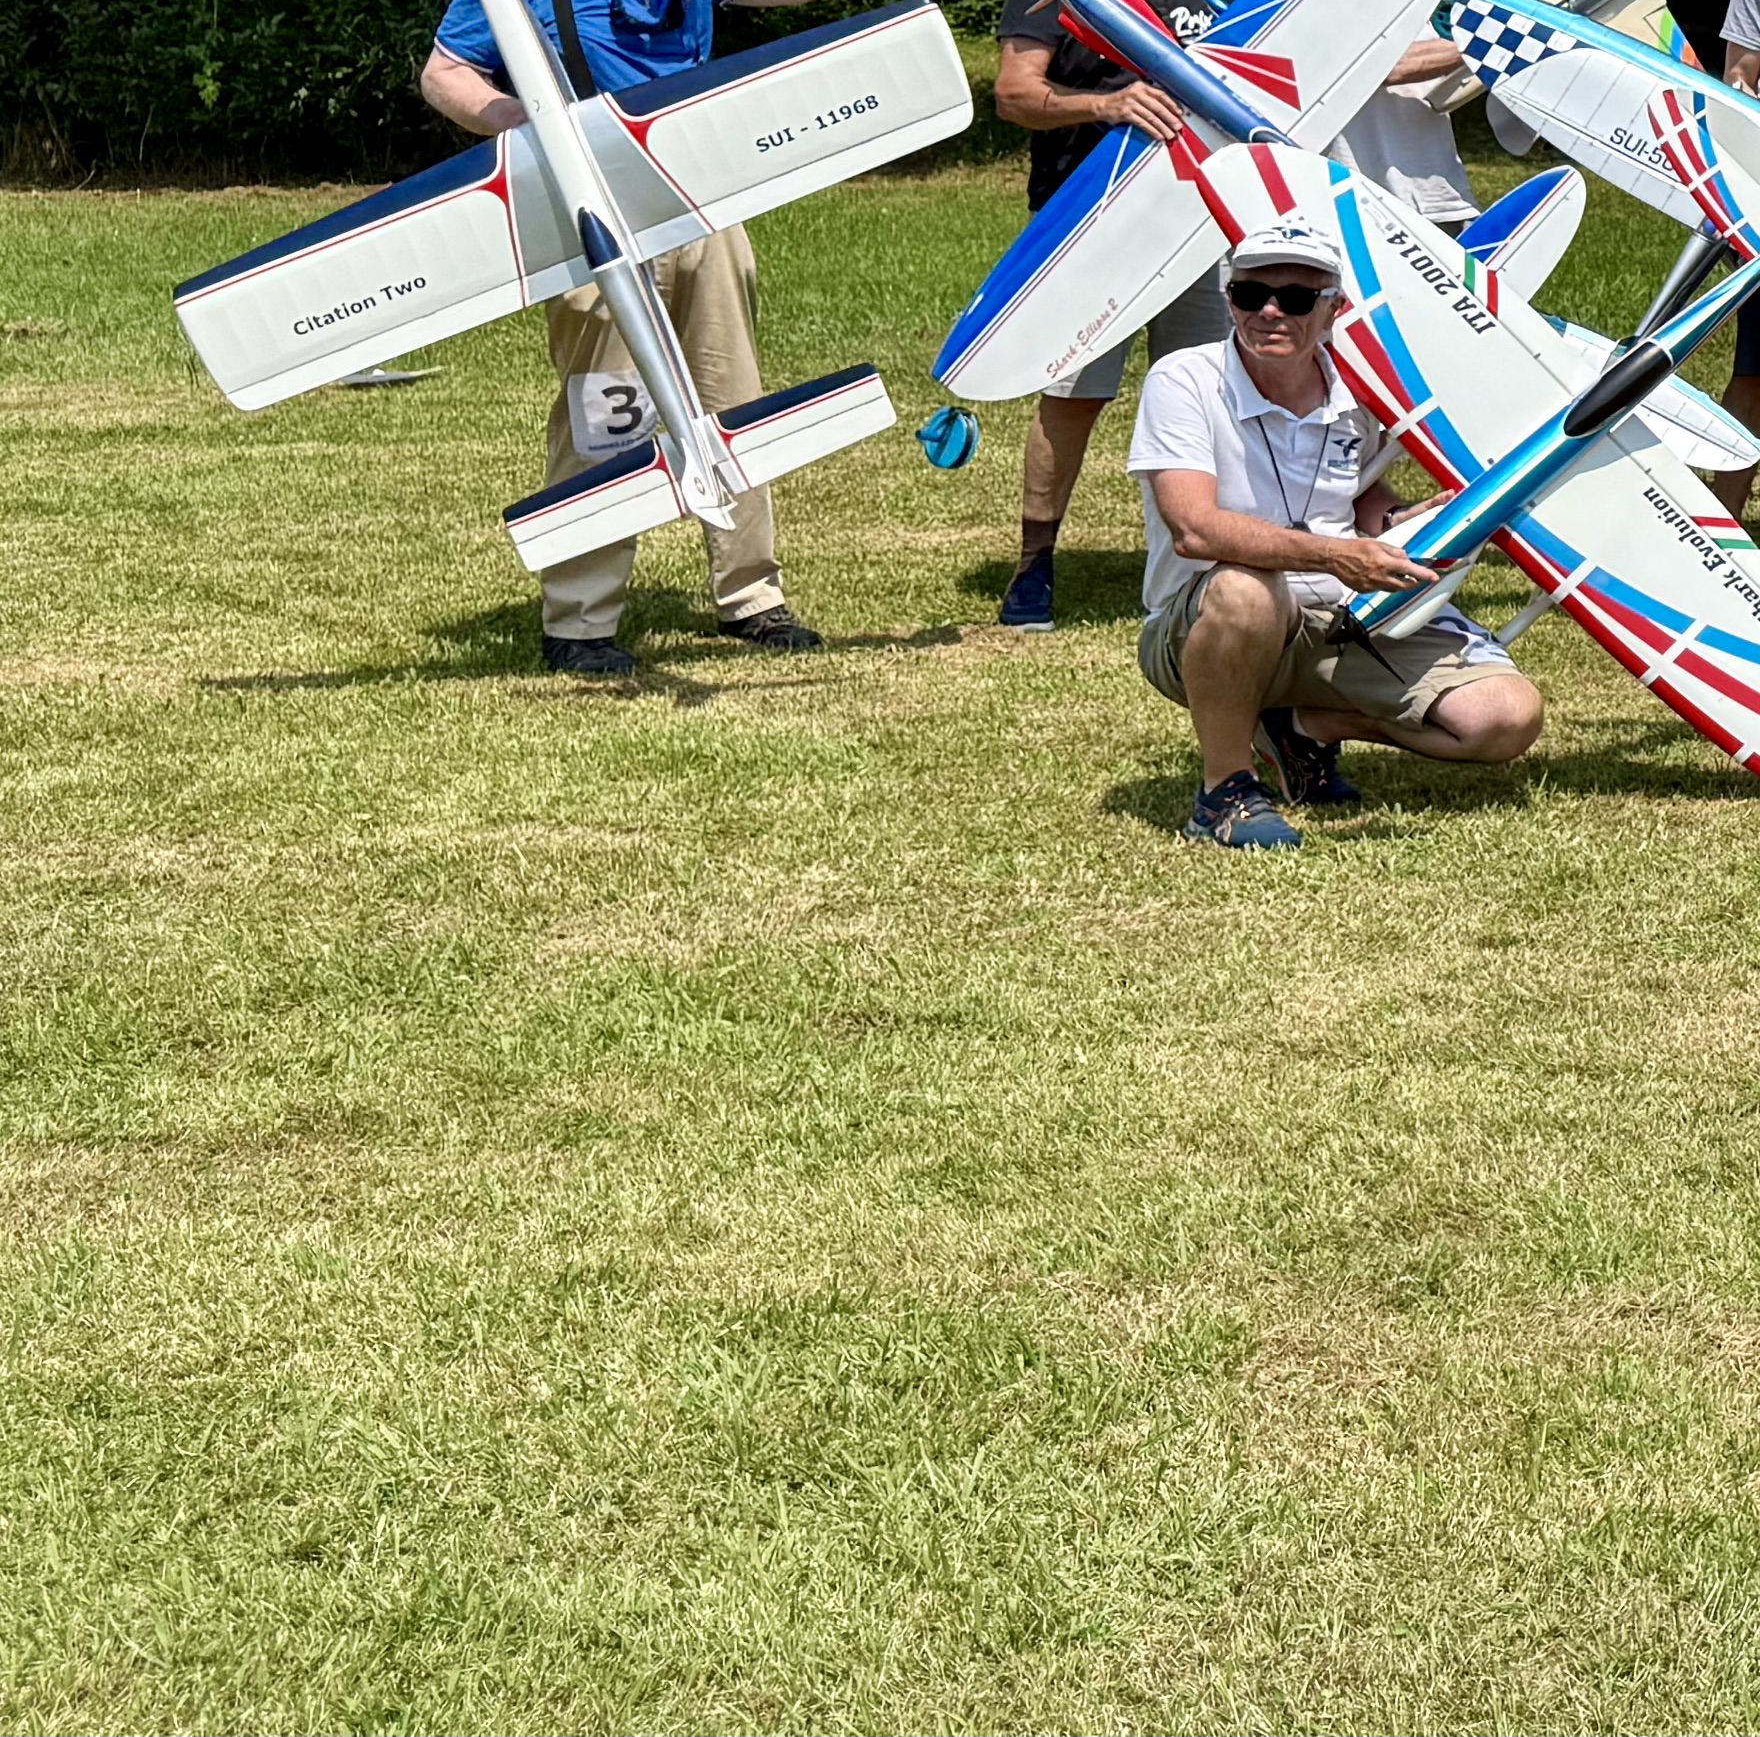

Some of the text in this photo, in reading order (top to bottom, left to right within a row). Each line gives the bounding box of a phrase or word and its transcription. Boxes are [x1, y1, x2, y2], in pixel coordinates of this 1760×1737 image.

[755, 126, 796, 153] SUI
[814, 94, 880, 130] 11968
[292, 276, 427, 336] Citation Two
[1107, 297, 1119, 311] 2
[1386, 229, 1497, 335] ITA 20014
[601, 385, 643, 436] 3
[1642, 486, 1727, 572] Evolution
